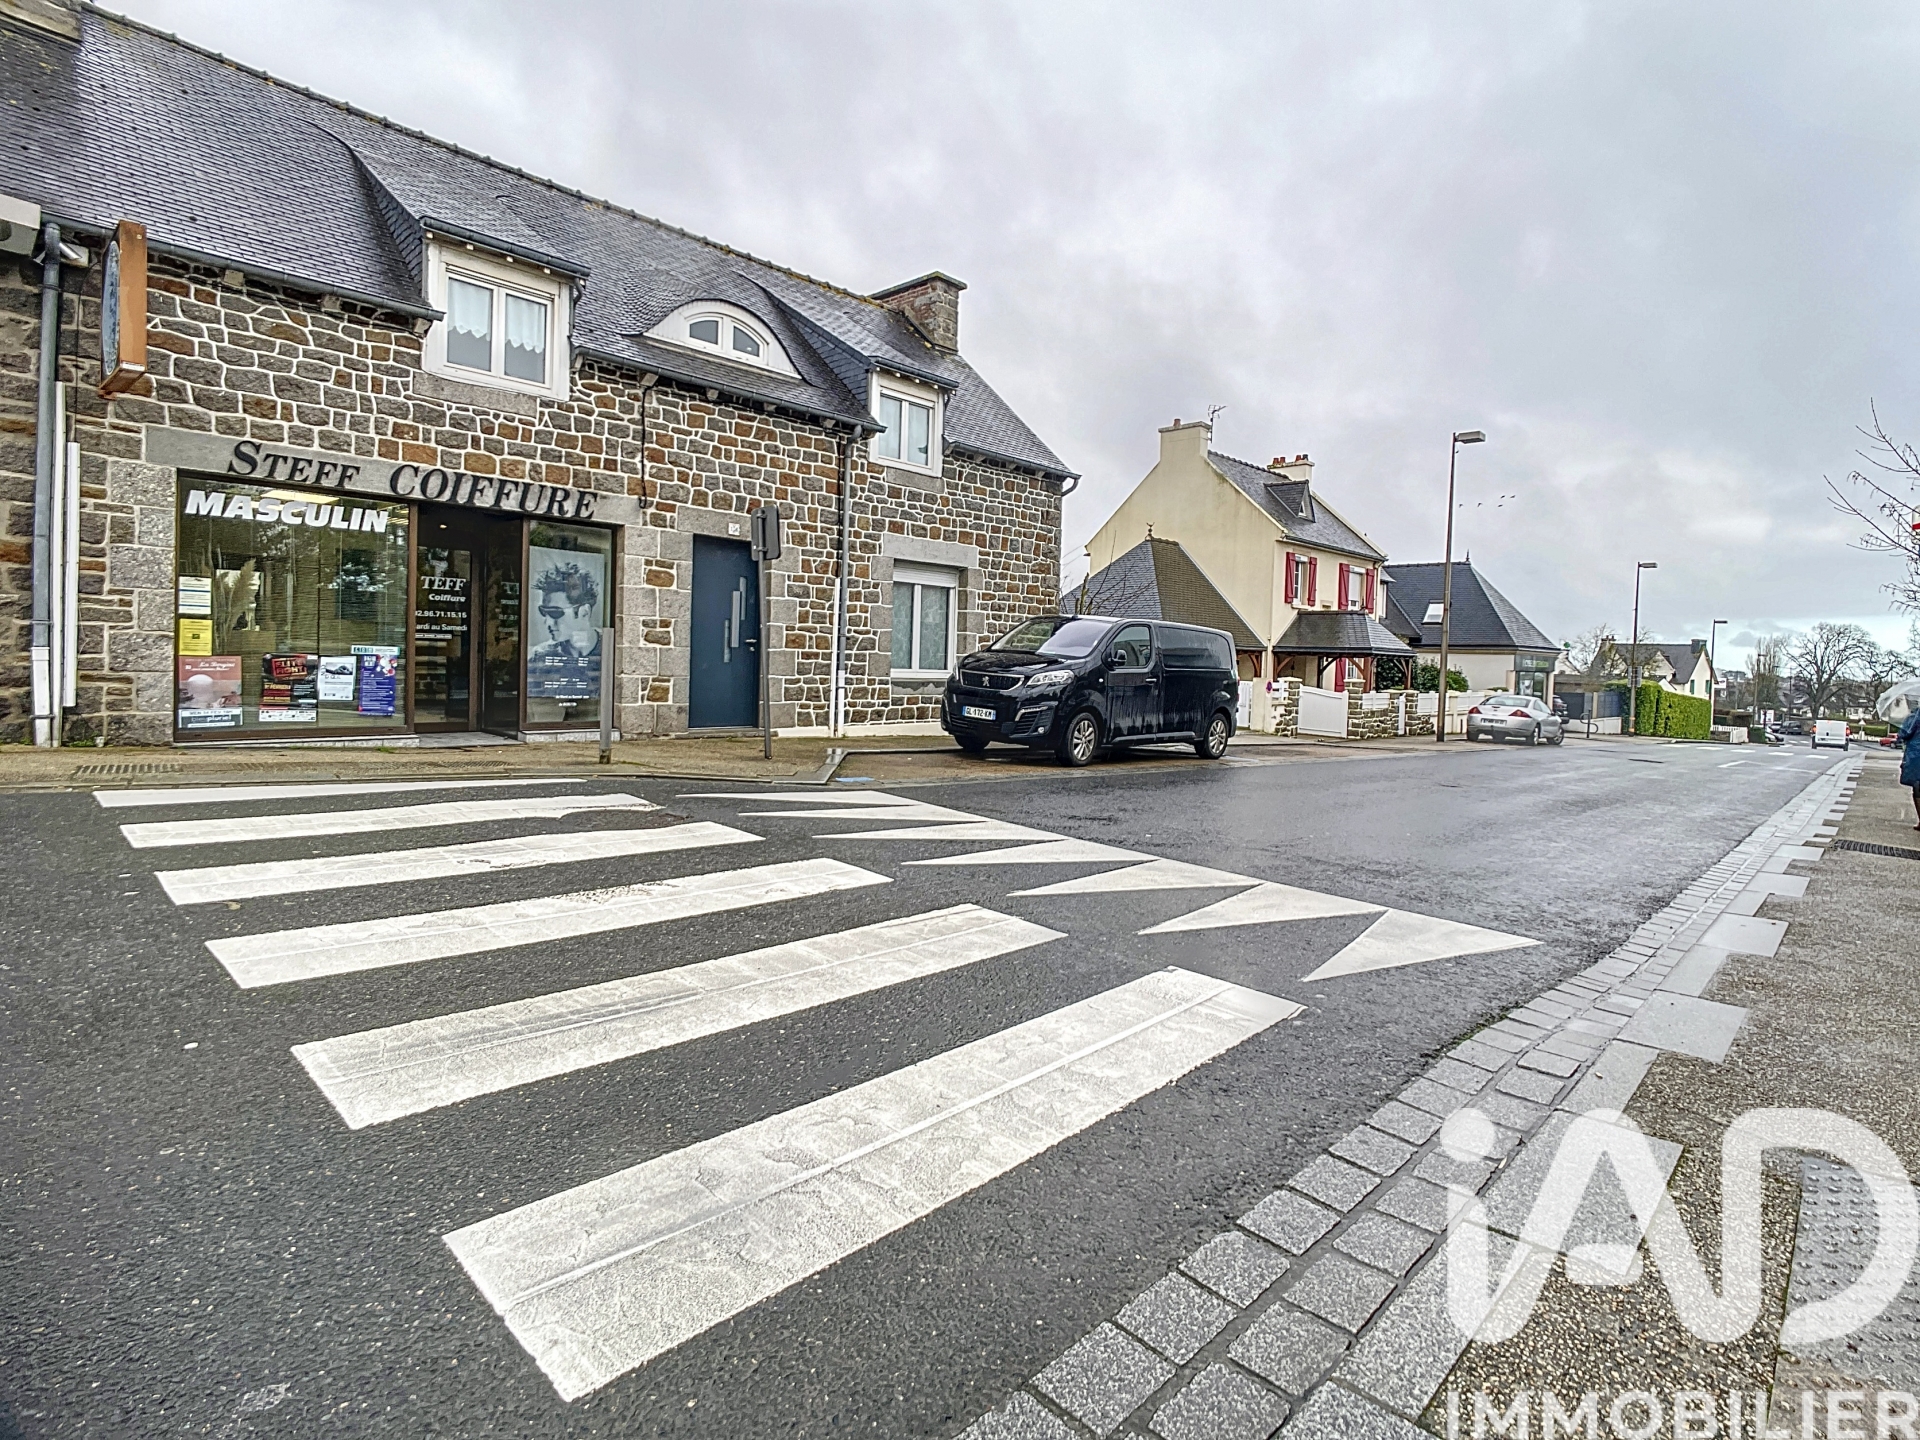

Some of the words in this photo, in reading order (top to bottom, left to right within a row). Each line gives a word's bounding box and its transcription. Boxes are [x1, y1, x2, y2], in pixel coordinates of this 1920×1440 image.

[227, 440, 361, 488] STEFF
[390, 464, 599, 519] COIFFURE
[185, 490, 389, 532] MASCULIN
[429, 593, 466, 602] Coiffure
[441, 623, 468, 631] Samedi
